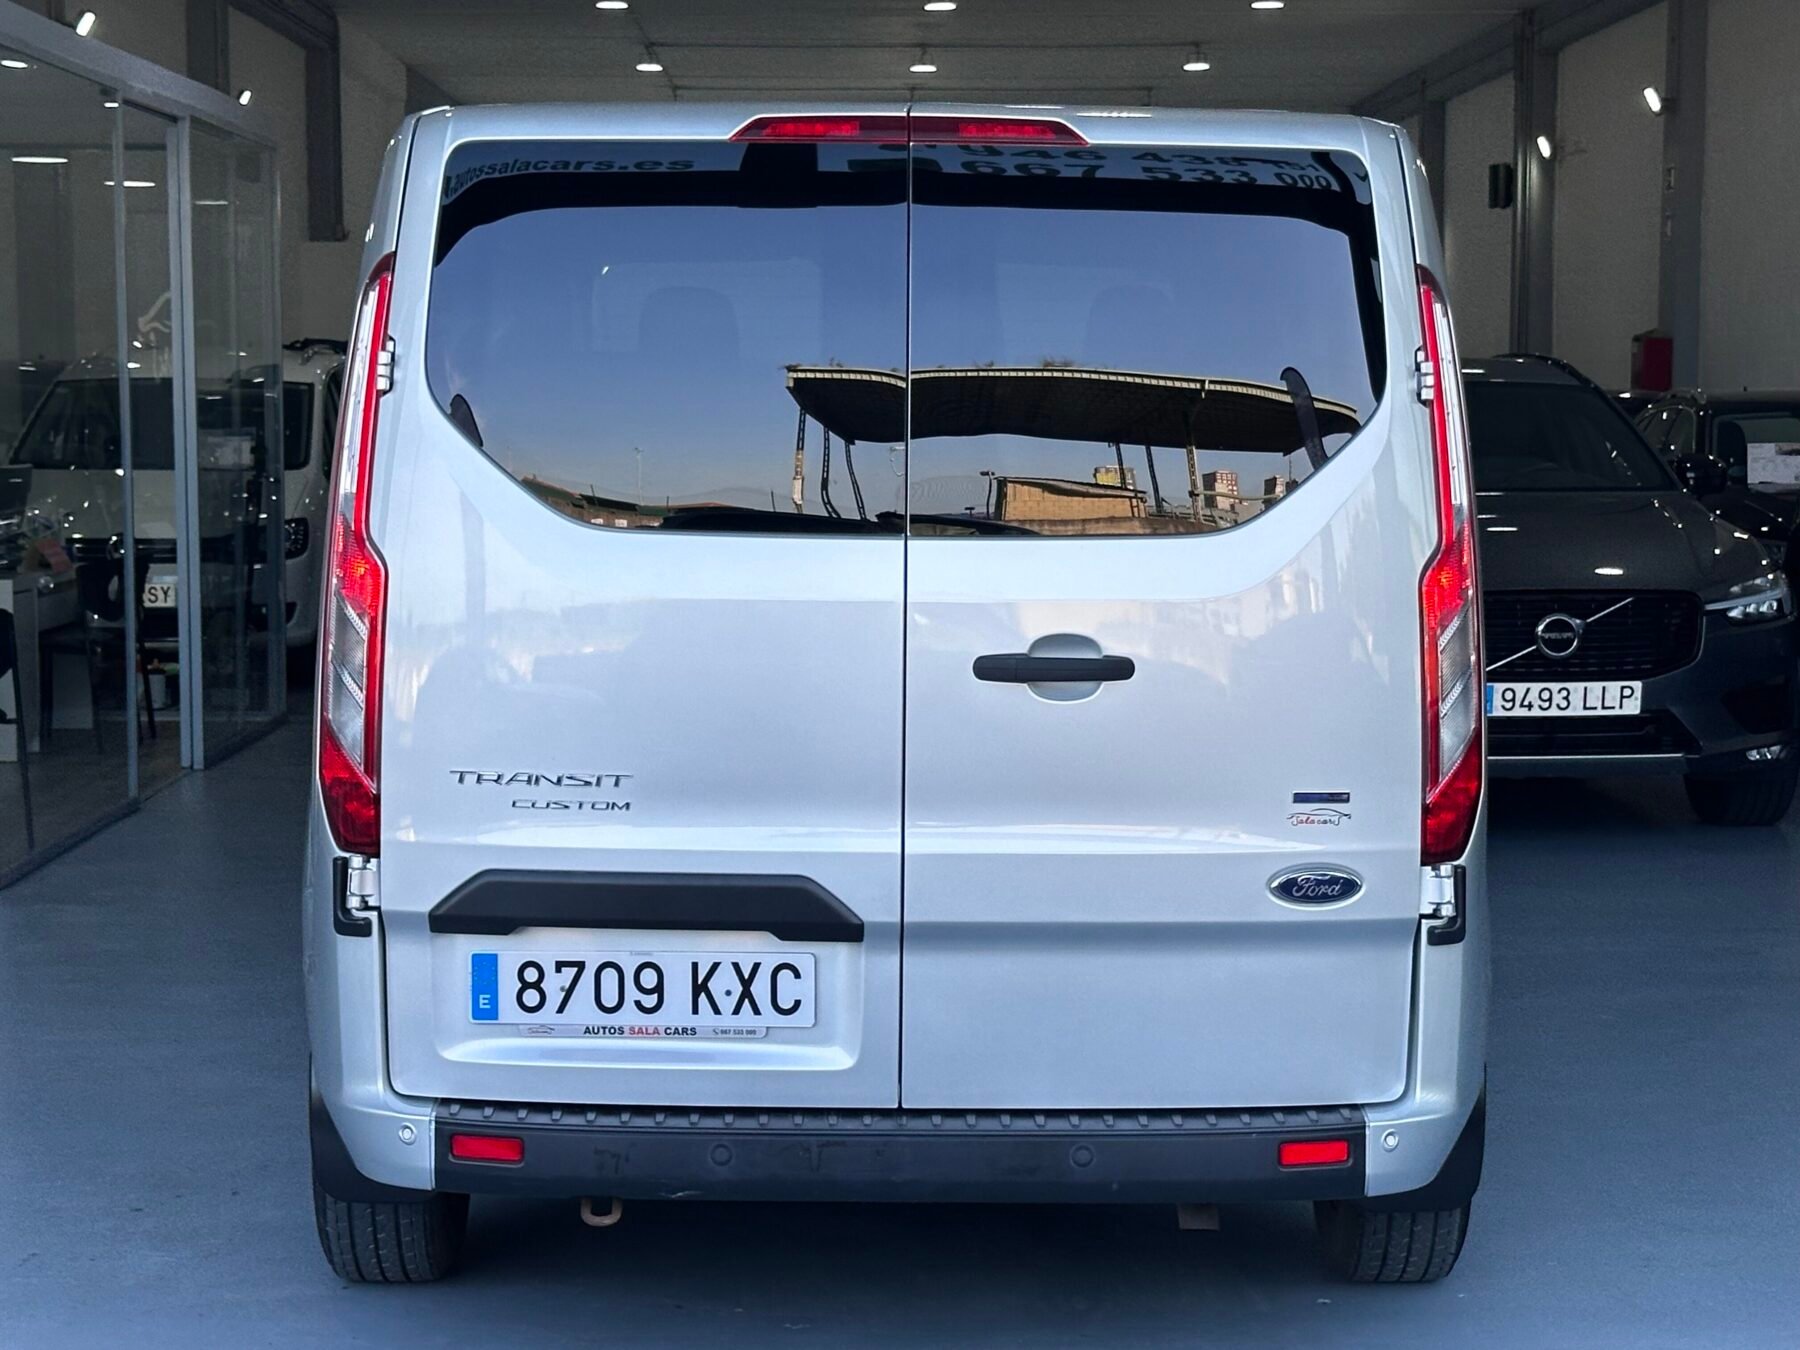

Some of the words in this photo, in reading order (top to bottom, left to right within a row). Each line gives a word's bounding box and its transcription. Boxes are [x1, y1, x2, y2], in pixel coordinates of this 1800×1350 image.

[959, 160, 1105, 179] 667
[1140, 166, 1258, 184] 533
[1273, 171, 1333, 190] 000
[1501, 687, 1571, 712] 9493
[1582, 685, 1635, 711] LLP
[449, 770, 634, 788] TRANSIT
[511, 799, 632, 811] CUSTOM
[1292, 874, 1344, 897] Ford
[479, 995, 491, 1008] E
[515, 960, 665, 1015] 8709
[691, 961, 802, 1016] KXC
[583, 1026, 625, 1037] AUTOS
[628, 1026, 661, 1037] SALA
[664, 1026, 697, 1037] CARS
